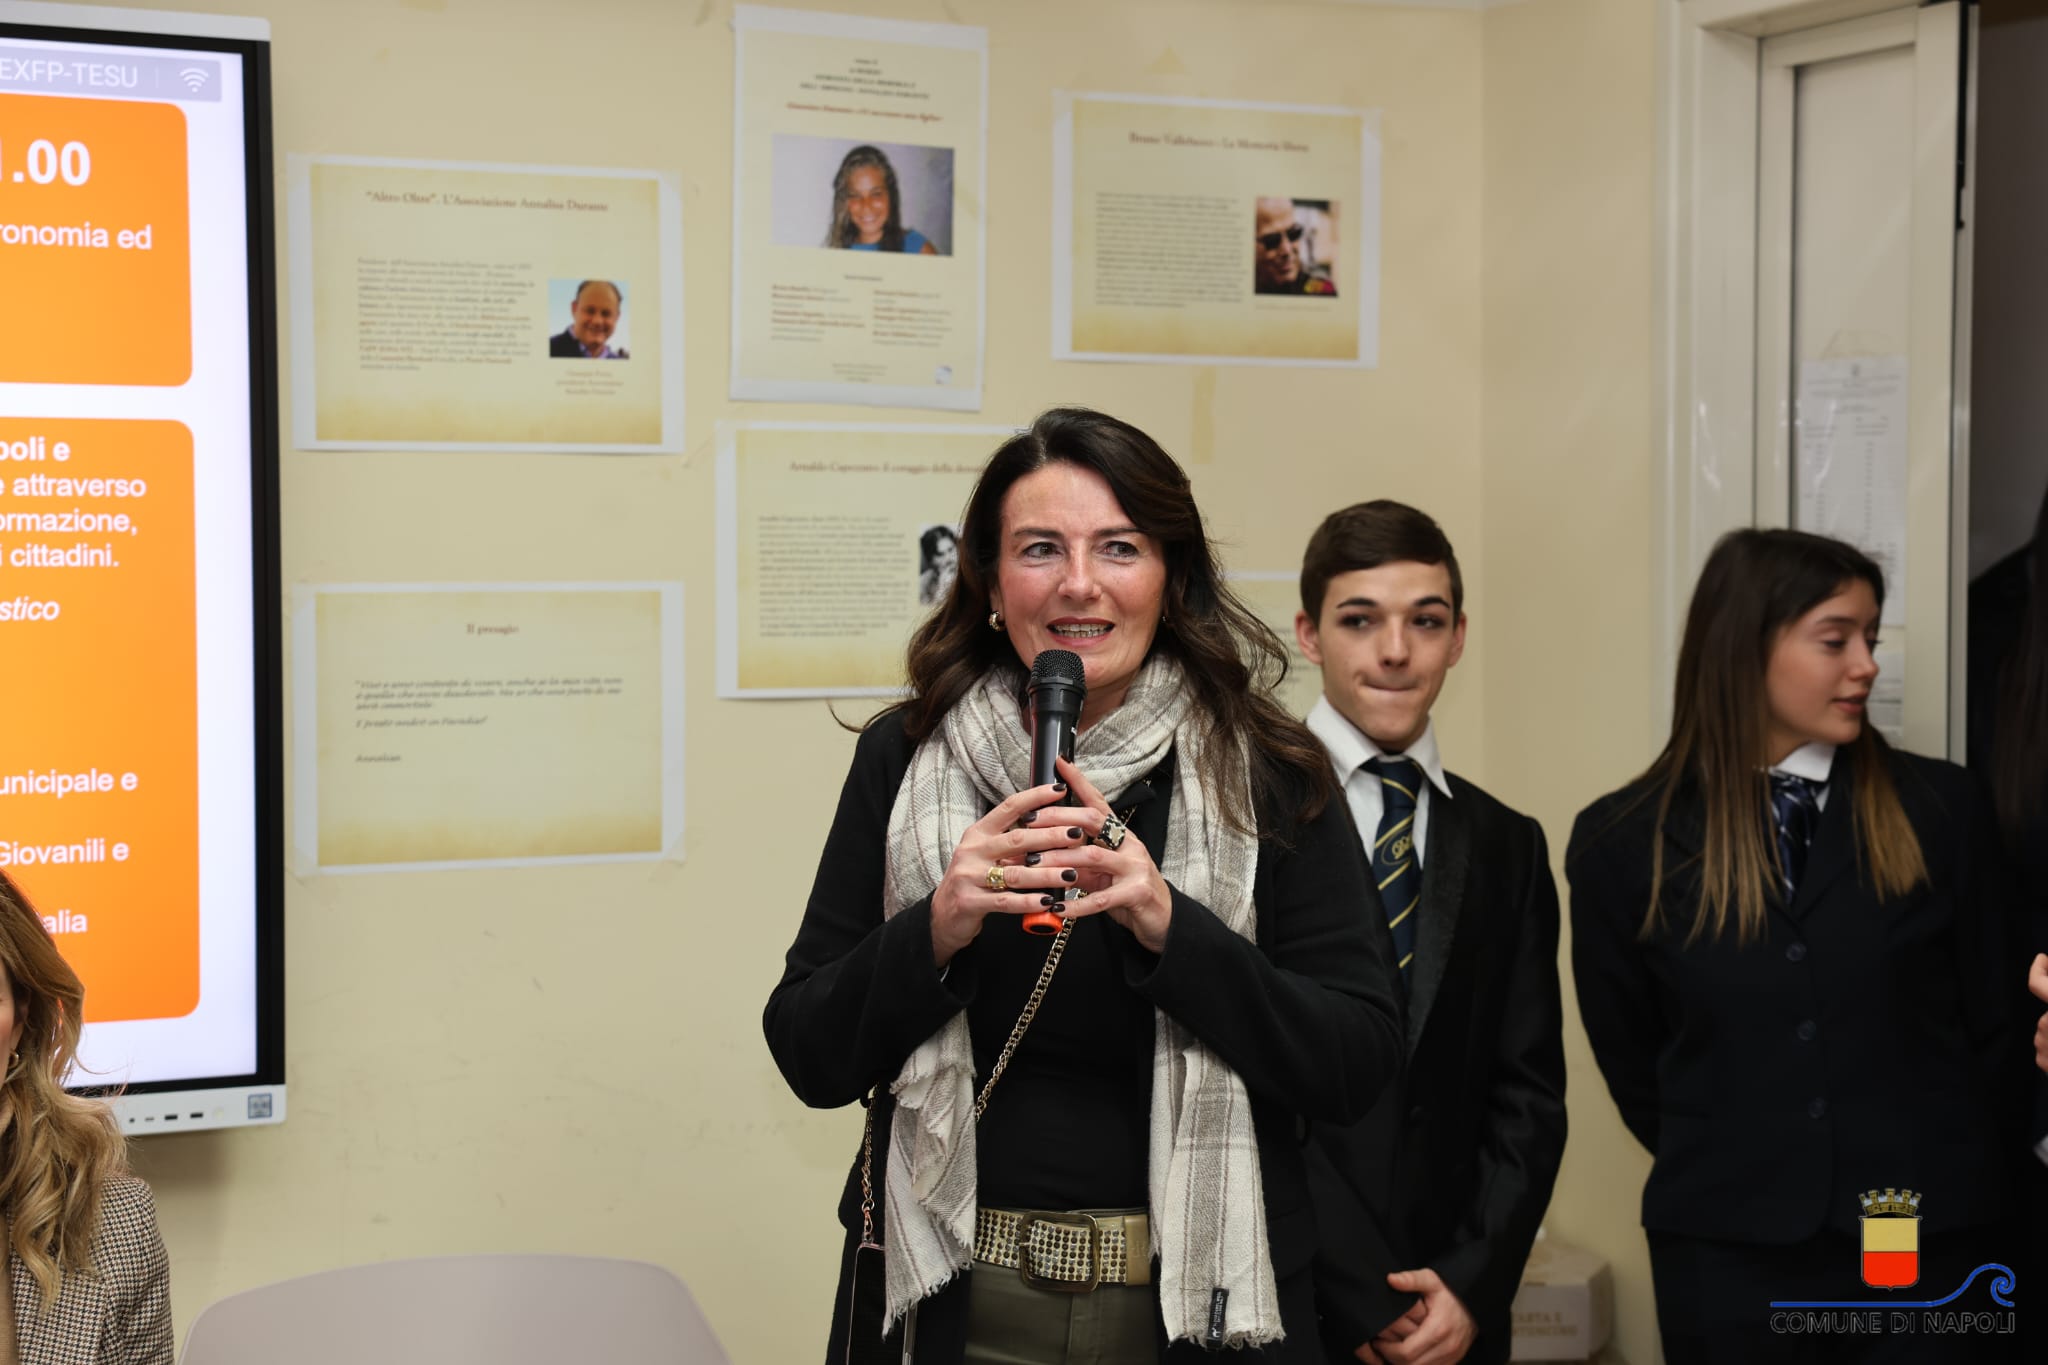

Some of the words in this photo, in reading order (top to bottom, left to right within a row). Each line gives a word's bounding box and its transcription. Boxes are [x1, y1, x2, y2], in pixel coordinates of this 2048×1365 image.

[0, 137, 91, 187] .00
[0, 221, 110, 248] onomia
[117, 223, 153, 250] ed
[53, 441, 71, 462] e
[12, 473, 147, 497] attraverso
[10, 543, 120, 567] cittadini.
[120, 771, 139, 792] e
[0, 837, 105, 868] Giovanili
[112, 842, 130, 862] e
[37, 908, 89, 935] alia
